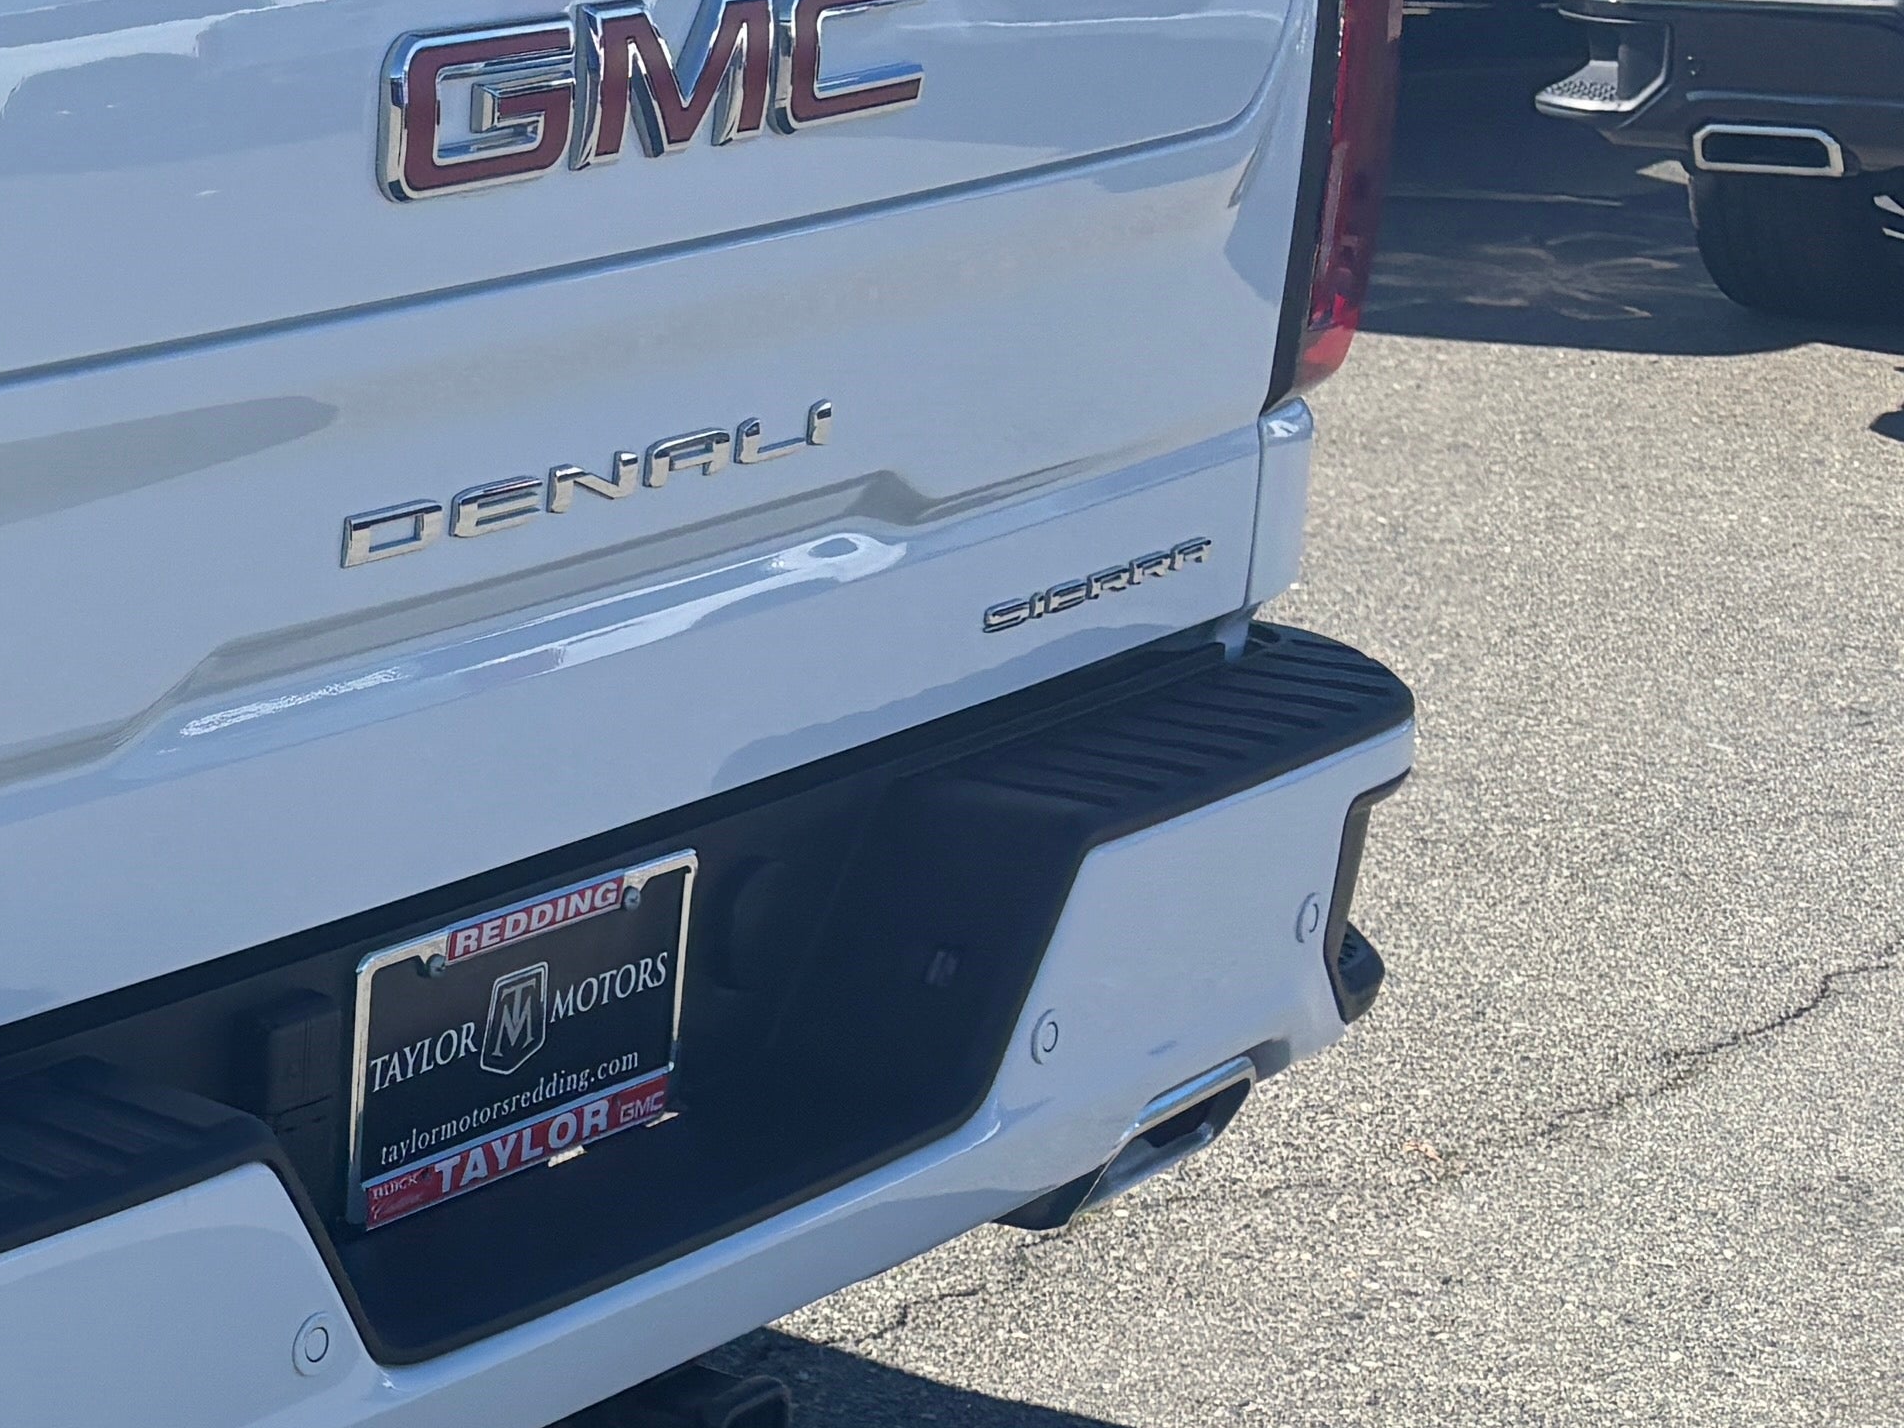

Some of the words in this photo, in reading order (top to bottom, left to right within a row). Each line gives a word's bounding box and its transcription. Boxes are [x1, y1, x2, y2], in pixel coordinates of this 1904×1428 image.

[340, 398, 833, 569] DENALI
[983, 537, 1212, 633] SIERRA
[454, 880, 618, 957] REDDING
[370, 1021, 478, 1093] TAYLOR
[550, 952, 668, 1023] MOTORS
[380, 1051, 640, 1169] taylormotorsredding.com
[435, 1099, 610, 1194] TAYLOR
[619, 1090, 665, 1123] GMC
